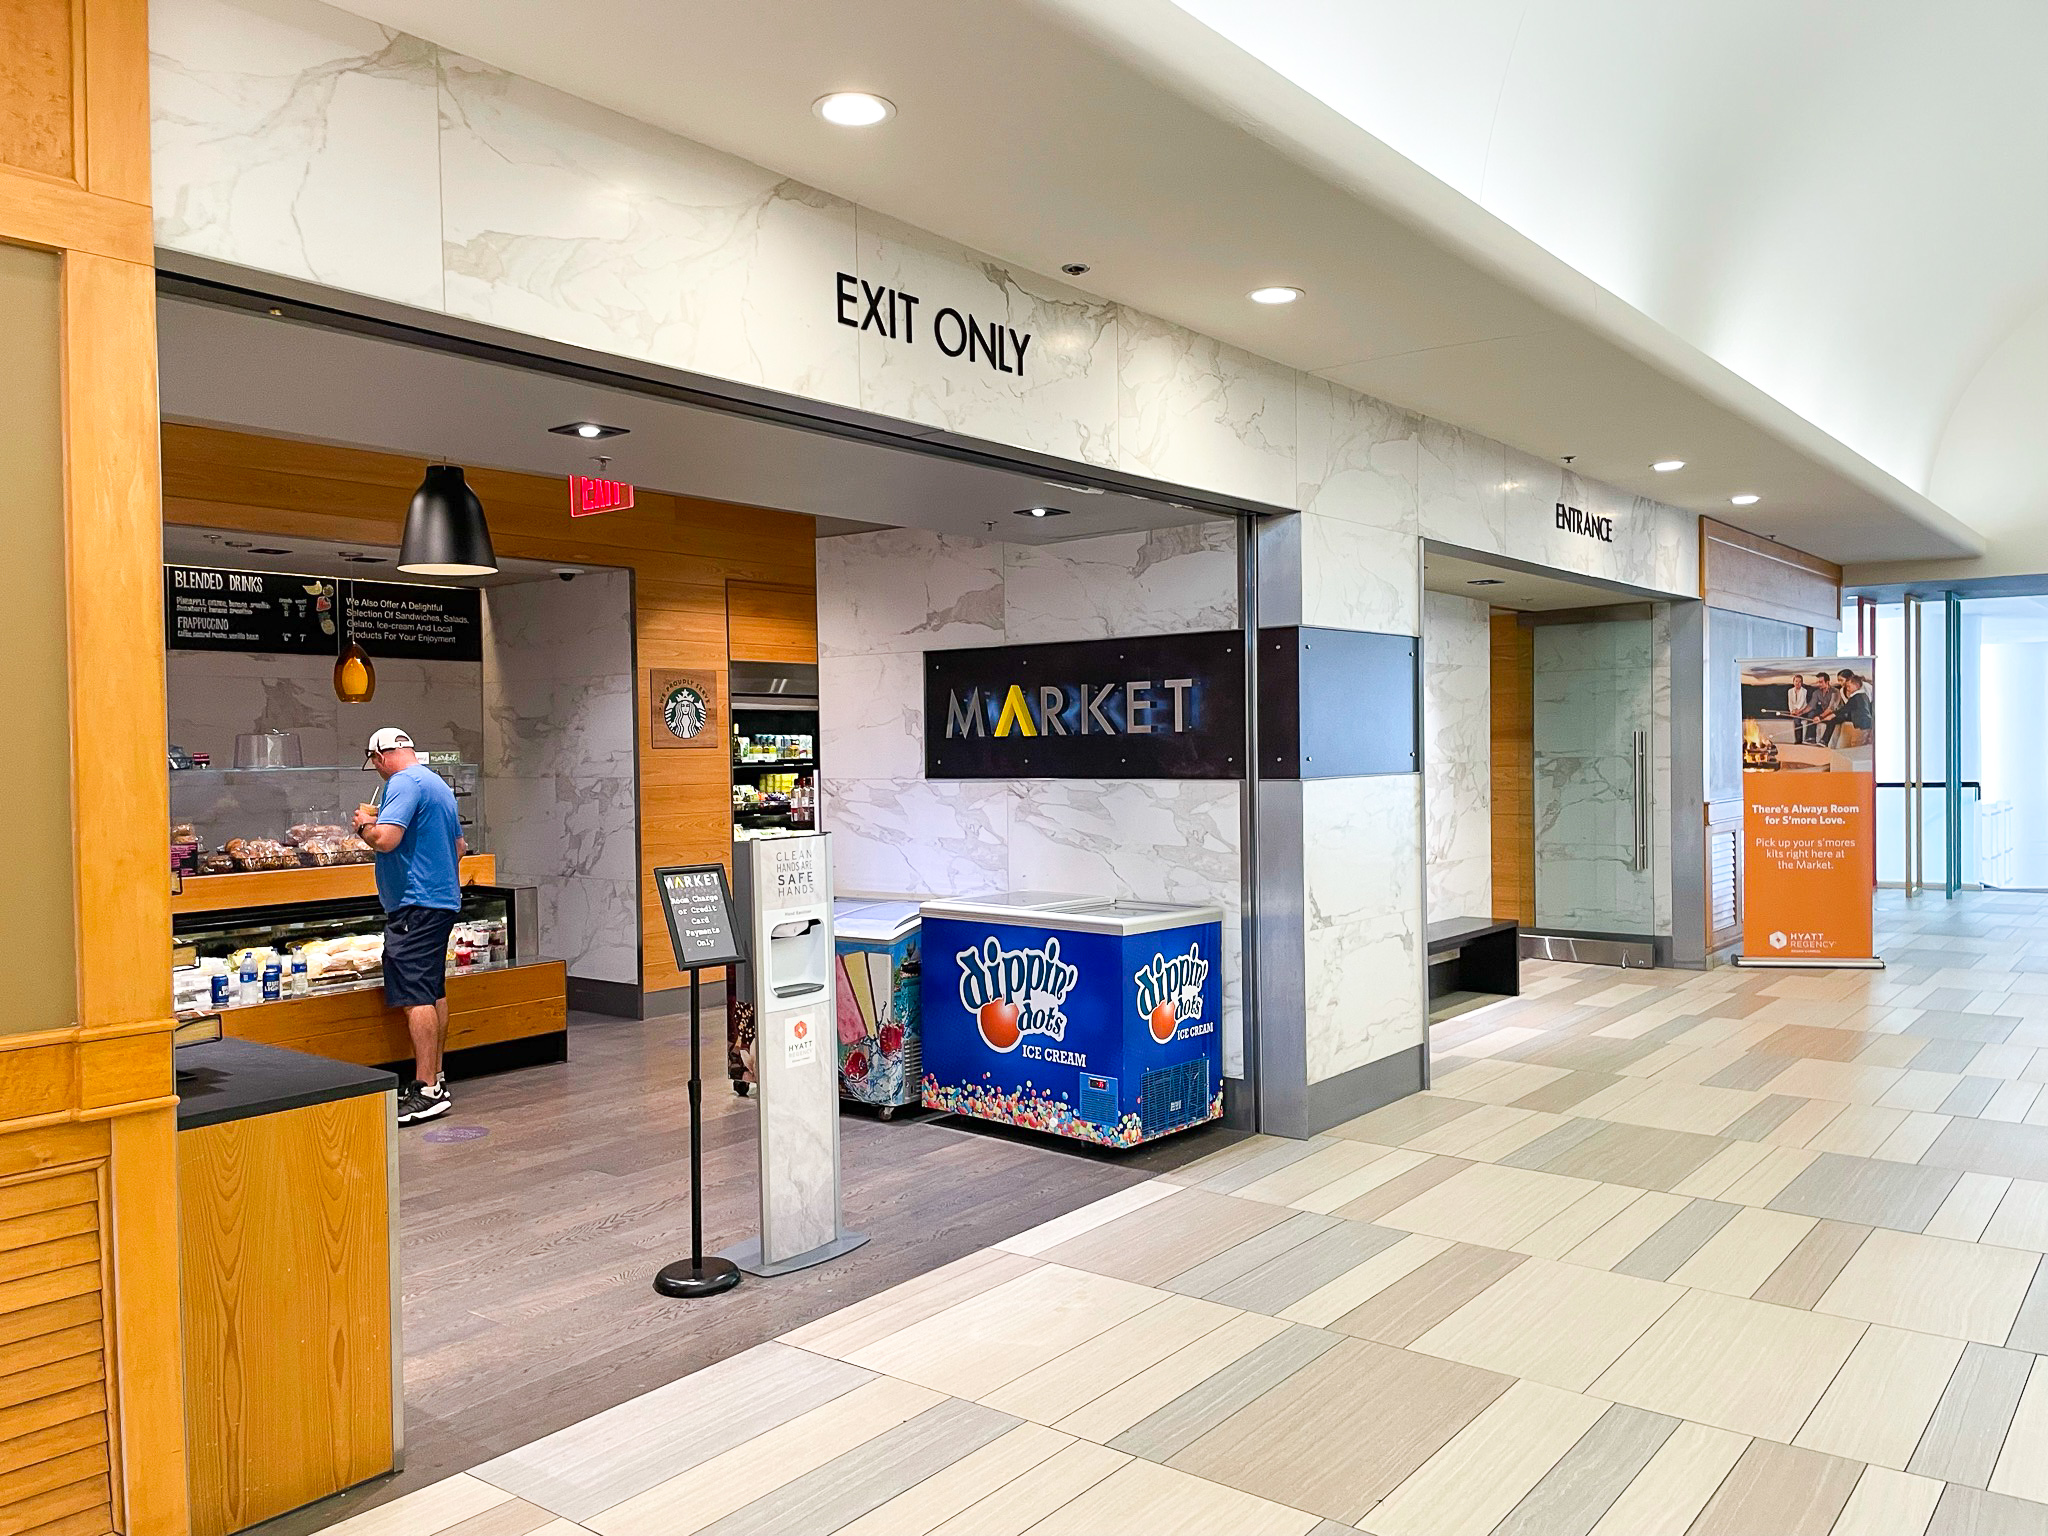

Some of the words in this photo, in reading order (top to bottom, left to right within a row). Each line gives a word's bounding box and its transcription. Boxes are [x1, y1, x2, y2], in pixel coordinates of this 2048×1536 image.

[837, 272, 919, 343] EXIT
[934, 307, 1031, 376] ONLY
[1556, 503, 1612, 542] ENTRANCE
[175, 571, 223, 590] BLENDED
[229, 574, 263, 592] DRINKS
[345, 598, 359, 606] We
[361, 599, 378, 607] Also
[380, 600, 399, 609] Offer
[408, 601, 443, 613] Delightful
[346, 608, 382, 618] Selection
[384, 610, 393, 619] Of
[395, 611, 442, 623] Sandwiches,
[177, 616, 229, 631] FRAPPUCCINO
[376, 620, 414, 631] Ice-cream
[416, 623, 431, 632] And
[433, 624, 453, 633] Local
[346, 630, 382, 640] Products
[384, 631, 397, 640] For
[399, 633, 416, 641] Your
[418, 634, 456, 643] Enjoyment
[666, 679, 695, 692] PROUDLY
[696, 683, 711, 704] SERVE
[946, 678, 1193, 739] MARKET
[1752, 804, 1788, 814] There's
[1791, 804, 1828, 815] Always
[1830, 804, 1859, 813] Room
[1765, 816, 1780, 824] for
[1782, 815, 1817, 825] S'more
[1820, 816, 1845, 825] Love.
[1755, 838, 1775, 847] Pick
[1778, 839, 1791, 849] up
[1793, 840, 1814, 849] your
[1817, 838, 1856, 847] s'mores
[776, 850, 812, 862] CLEAN
[1766, 849, 1784, 858] kits
[1786, 849, 1809, 860] right
[1811, 849, 1833, 858] here
[1835, 850, 1845, 858] at
[776, 861, 800, 873] HANDS
[800, 860, 813, 870] ARE
[1778, 860, 1794, 869] the
[1796, 860, 1834, 870] Market.
[664, 873, 719, 890] MARKET
[777, 871, 814, 886] SAFE
[778, 884, 814, 897] HANDS
[691, 895, 719, 903] Charge
[690, 905, 717, 914] Credit
[691, 916, 710, 925] Card
[685, 928, 720, 938] Payments
[1790, 932, 1824, 940] HYATT
[696, 939, 715, 947] Only
[1790, 940, 1835, 948] REGENCY
[957, 937, 1077, 1013] dippin'
[1135, 943, 1208, 1018] dippin'
[1174, 995, 1203, 1020] dots
[1017, 1001, 1065, 1038] dots
[1177, 1029, 1188, 1041] ICE
[1189, 1022, 1214, 1039] CREAM
[788, 1040, 812, 1052] HYATT
[1022, 1044, 1042, 1060] ICE
[1044, 1048, 1087, 1068] CREAM
